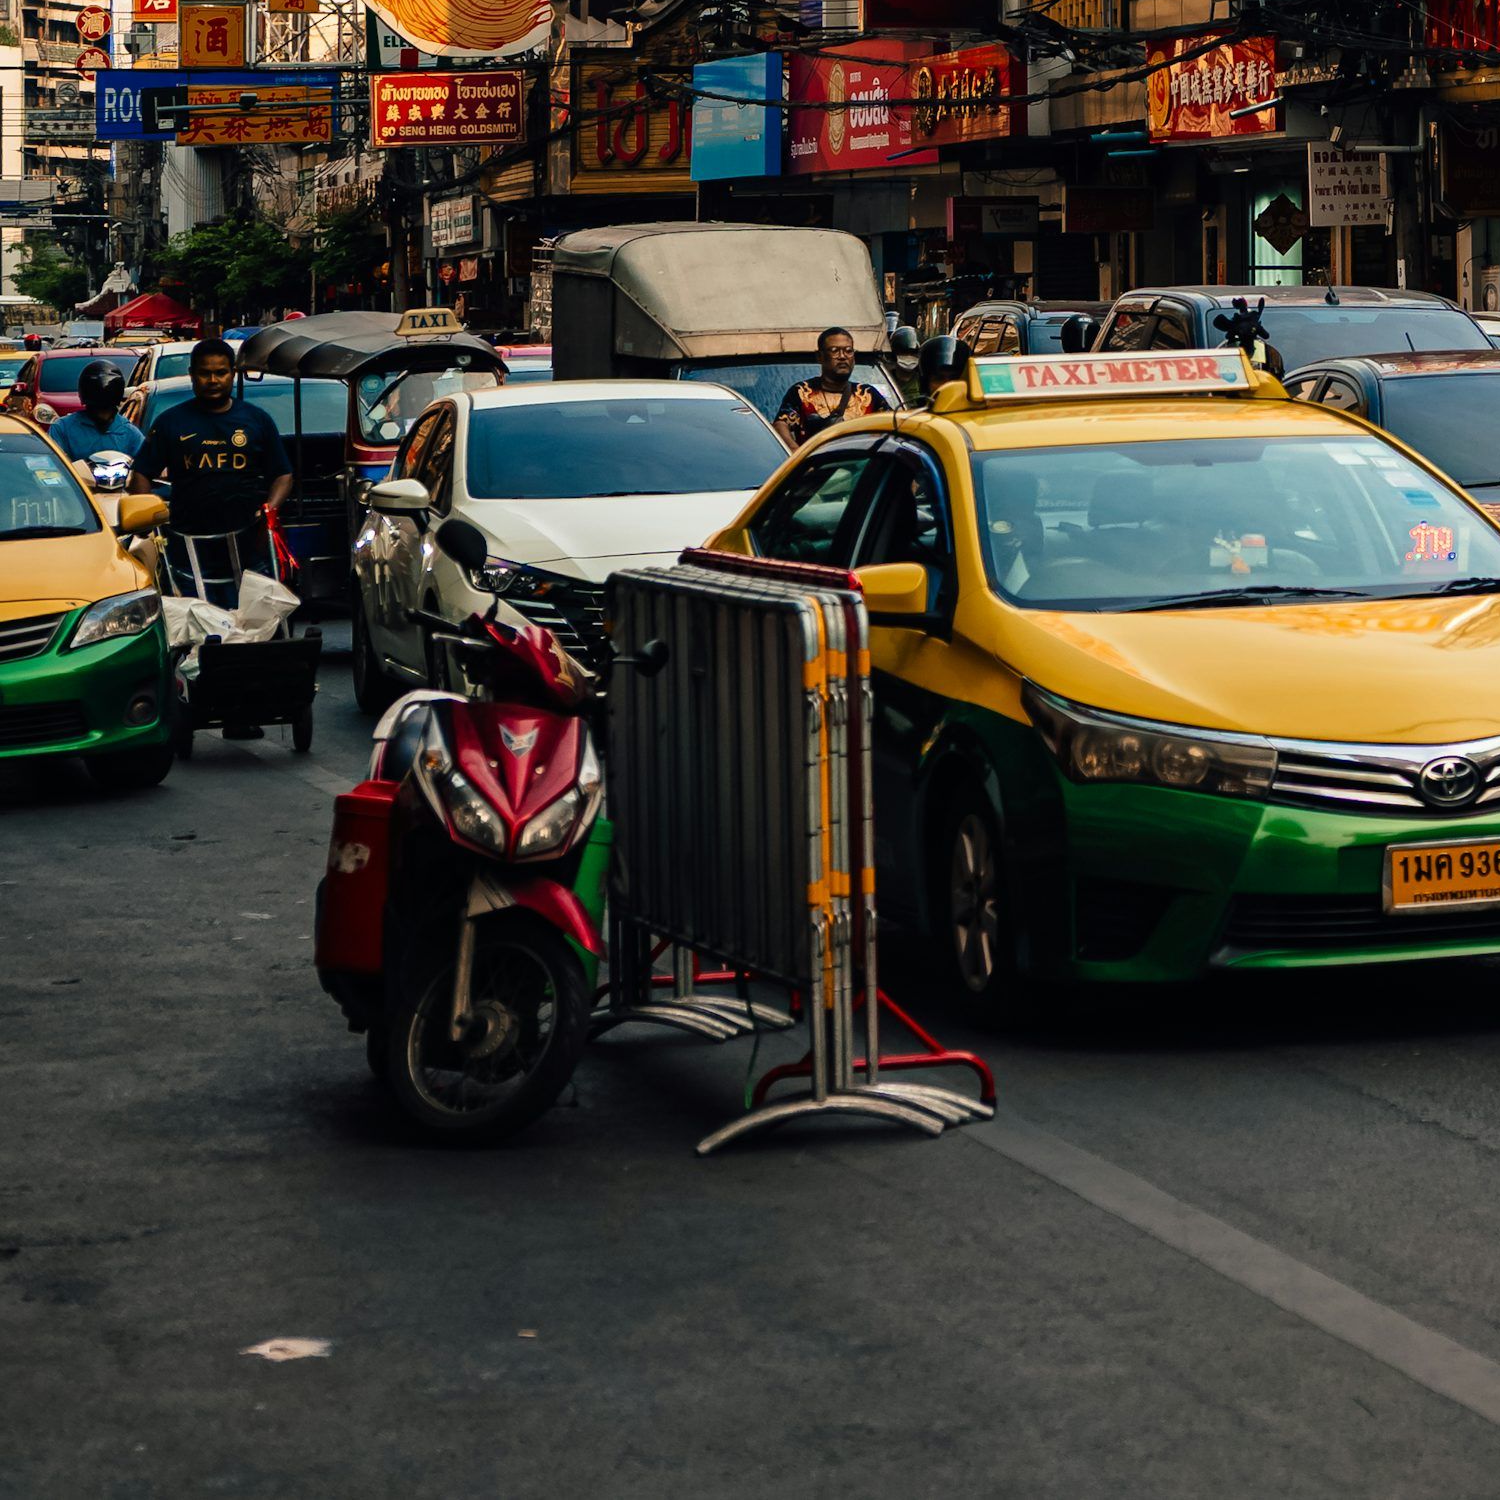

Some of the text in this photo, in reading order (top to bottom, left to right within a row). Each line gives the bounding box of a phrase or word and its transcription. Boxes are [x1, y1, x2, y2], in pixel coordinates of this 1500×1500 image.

[385, 103, 512, 121] 蘇成興大金行
[381, 123, 518, 137] SO SENG HENG GOLDSMITH
[409, 314, 448, 329] TAXI
[1018, 358, 1221, 389] TAXI-METER
[1399, 852, 1453, 884] 1มค
